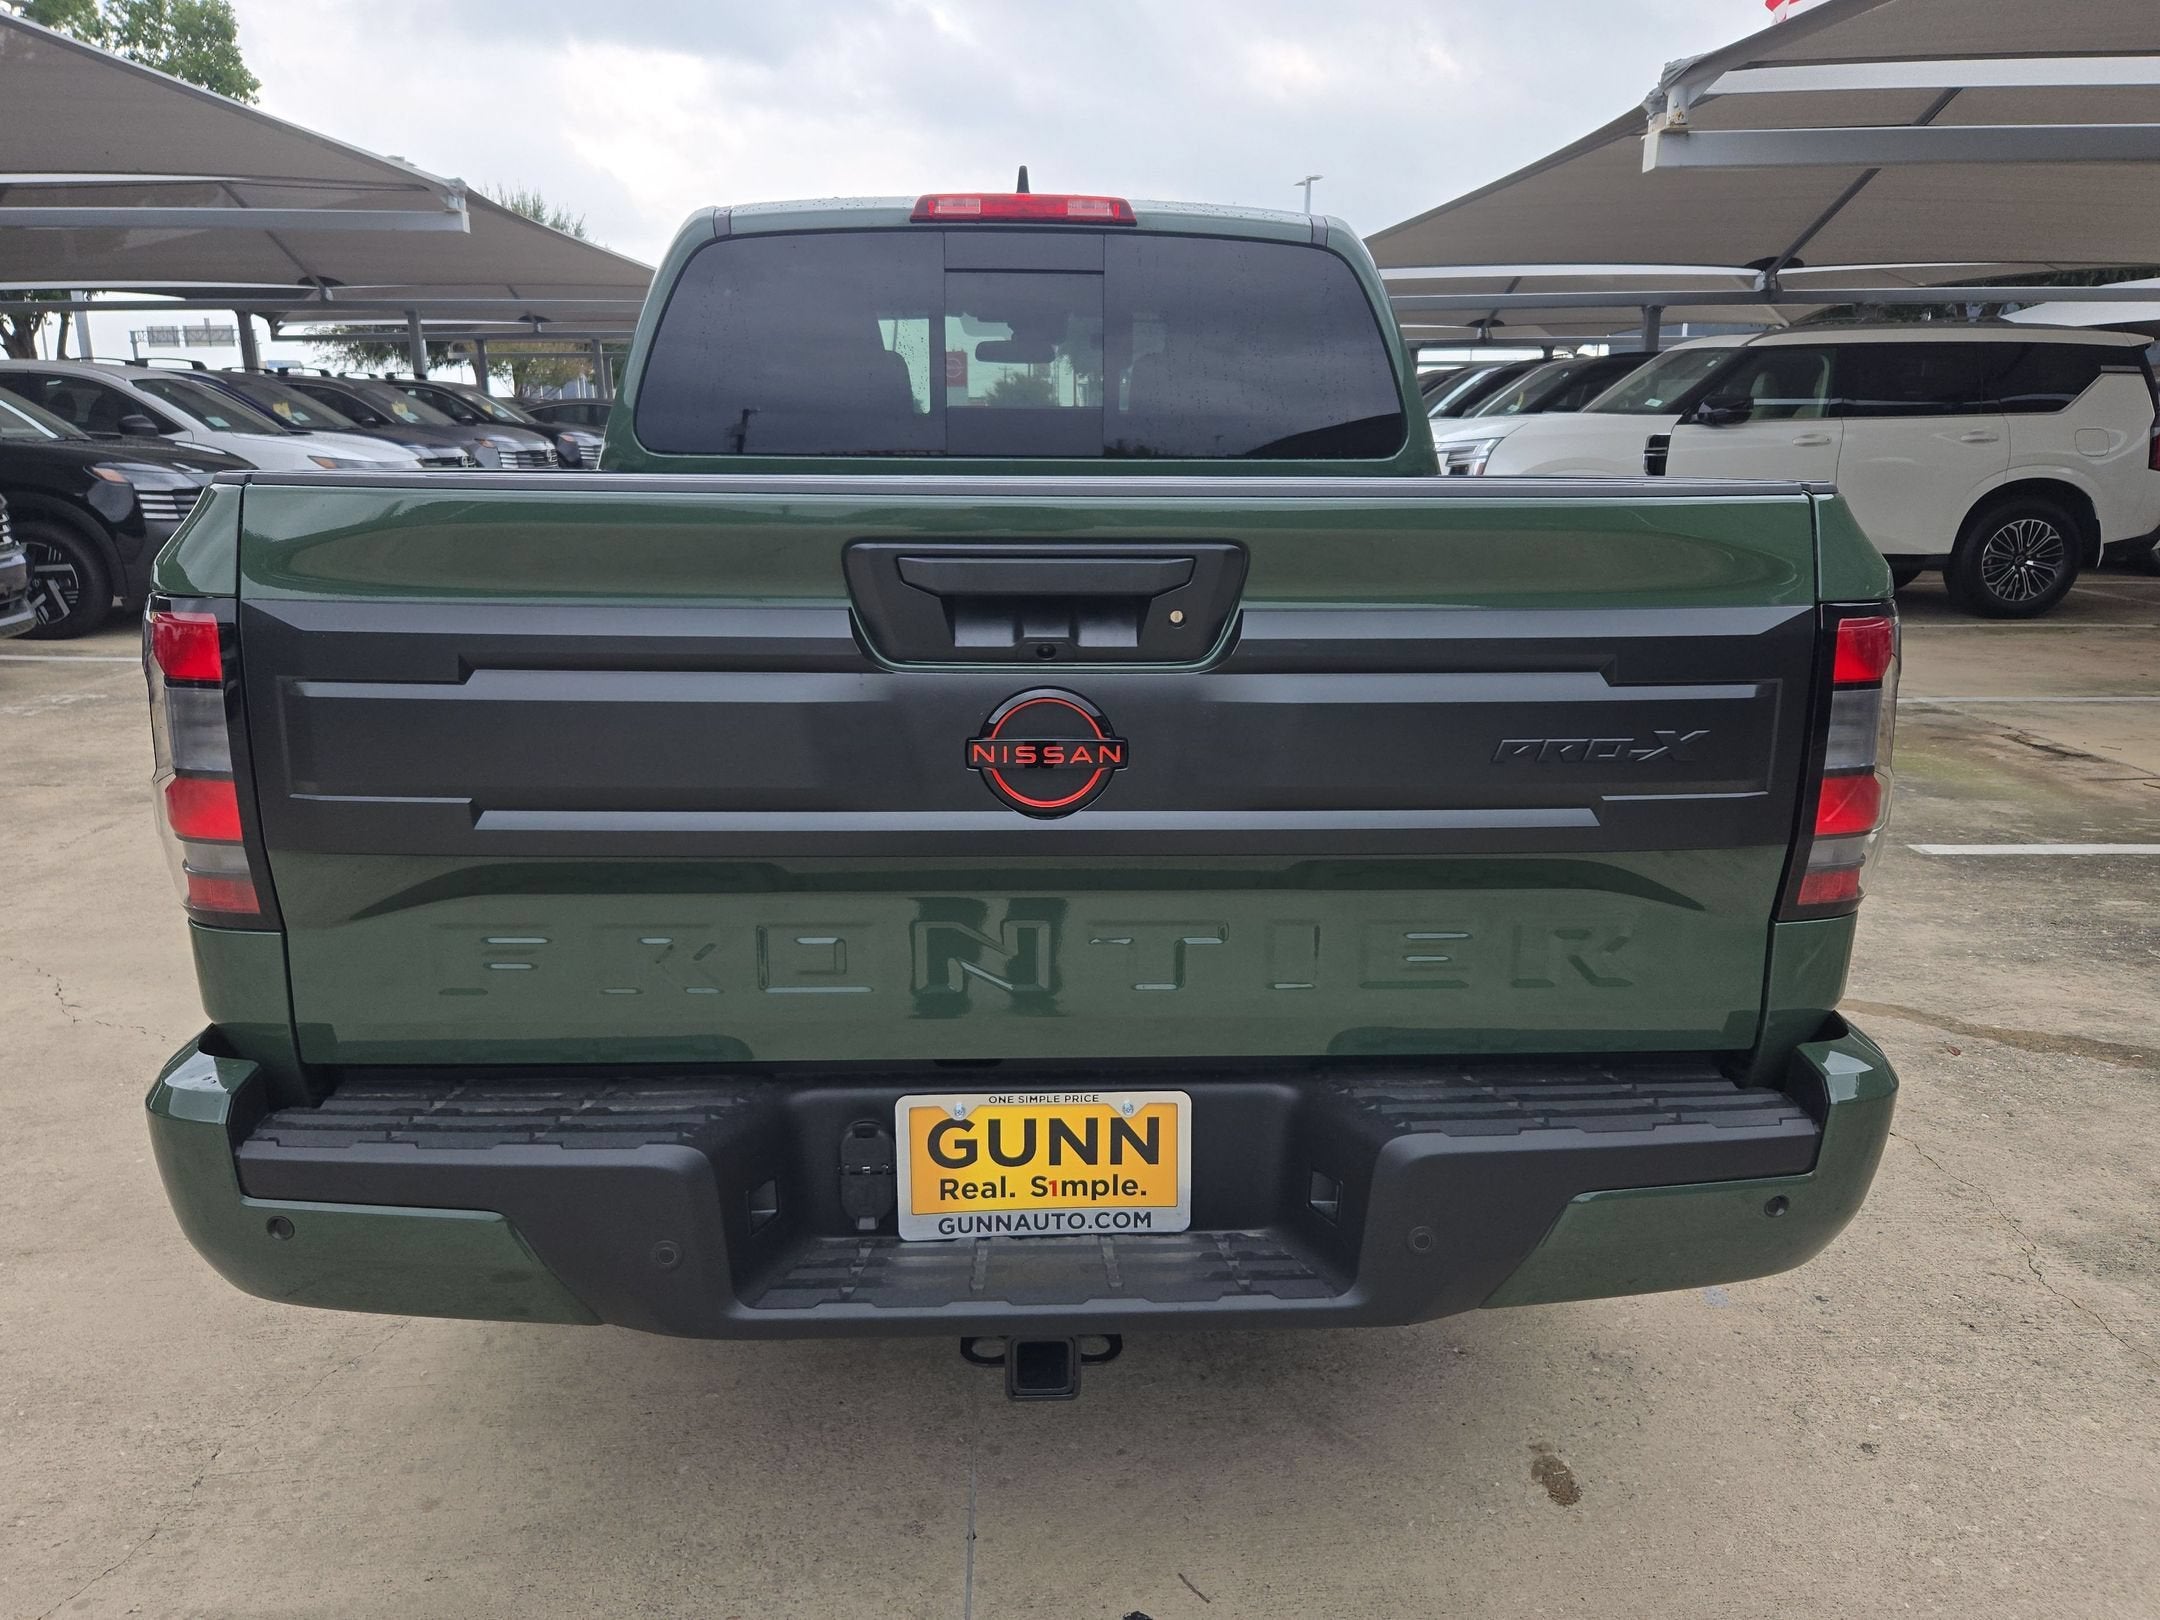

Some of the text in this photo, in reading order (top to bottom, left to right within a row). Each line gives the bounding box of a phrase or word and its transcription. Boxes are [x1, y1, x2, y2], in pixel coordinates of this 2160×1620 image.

[972, 744, 1121, 764] NISSAN
[1491, 730, 1711, 763] PRO-X
[433, 920, 1635, 997] FRONTIER
[988, 1094, 1100, 1104] ONE SIMPLE PRICE
[927, 1116, 1160, 1169] GUNN
[939, 1176, 1016, 1200] Real.
[938, 1211, 1152, 1236] GUNNAUTO.COM
